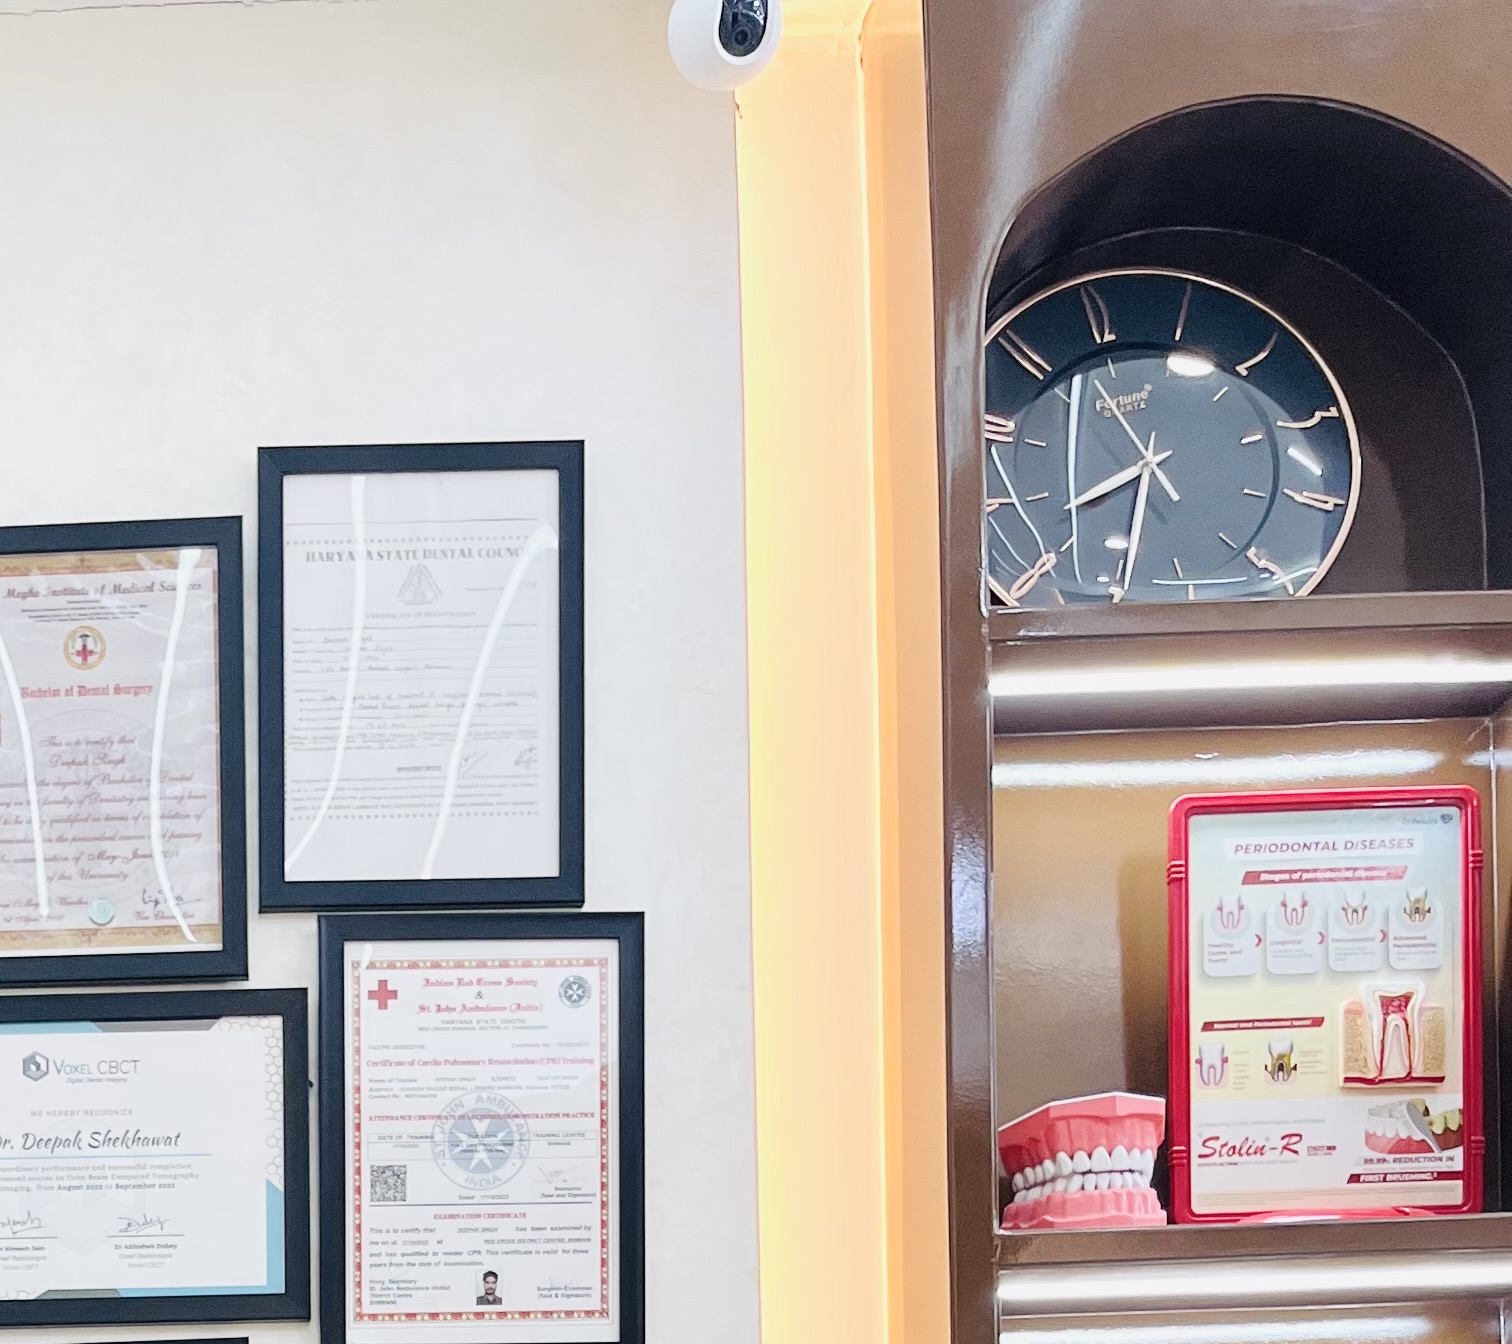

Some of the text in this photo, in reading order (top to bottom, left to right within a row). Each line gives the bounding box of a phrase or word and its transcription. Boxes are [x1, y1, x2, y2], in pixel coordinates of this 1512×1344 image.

[306, 550, 373, 563] HARYAA
[423, 547, 474, 560] DENTAL
[1234, 838, 1414, 854] PERIODONTAL DISEASES
[475, 990, 484, 999] &
[97, 1059, 140, 1075] CBCT
[22, 1130, 83, 1154] Deepak
[88, 1129, 181, 1149] Shekhawat
